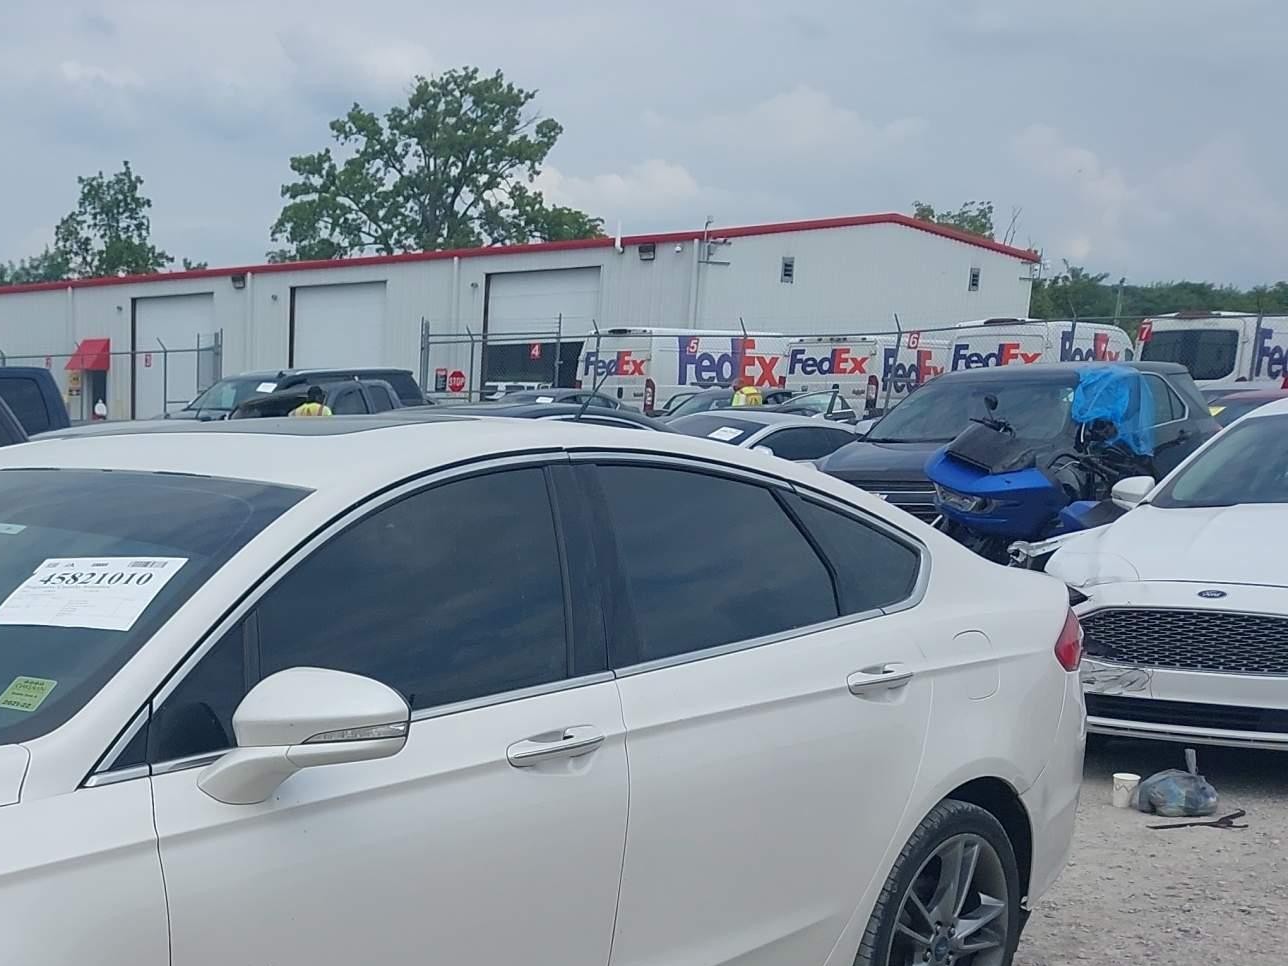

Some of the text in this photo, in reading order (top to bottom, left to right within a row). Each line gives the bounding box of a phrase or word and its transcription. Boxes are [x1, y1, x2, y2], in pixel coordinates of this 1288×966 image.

[1141, 325, 1151, 339] 7
[688, 339, 698, 352] 5
[909, 333, 918, 347] 6
[1255, 328, 1288, 379] Fe
[584, 351, 646, 376] FedEx
[678, 336, 779, 386] FedEx
[788, 348, 870, 375] FedEx
[449, 376, 465, 385] STOP
[40, 572, 153, 586] 45821010
